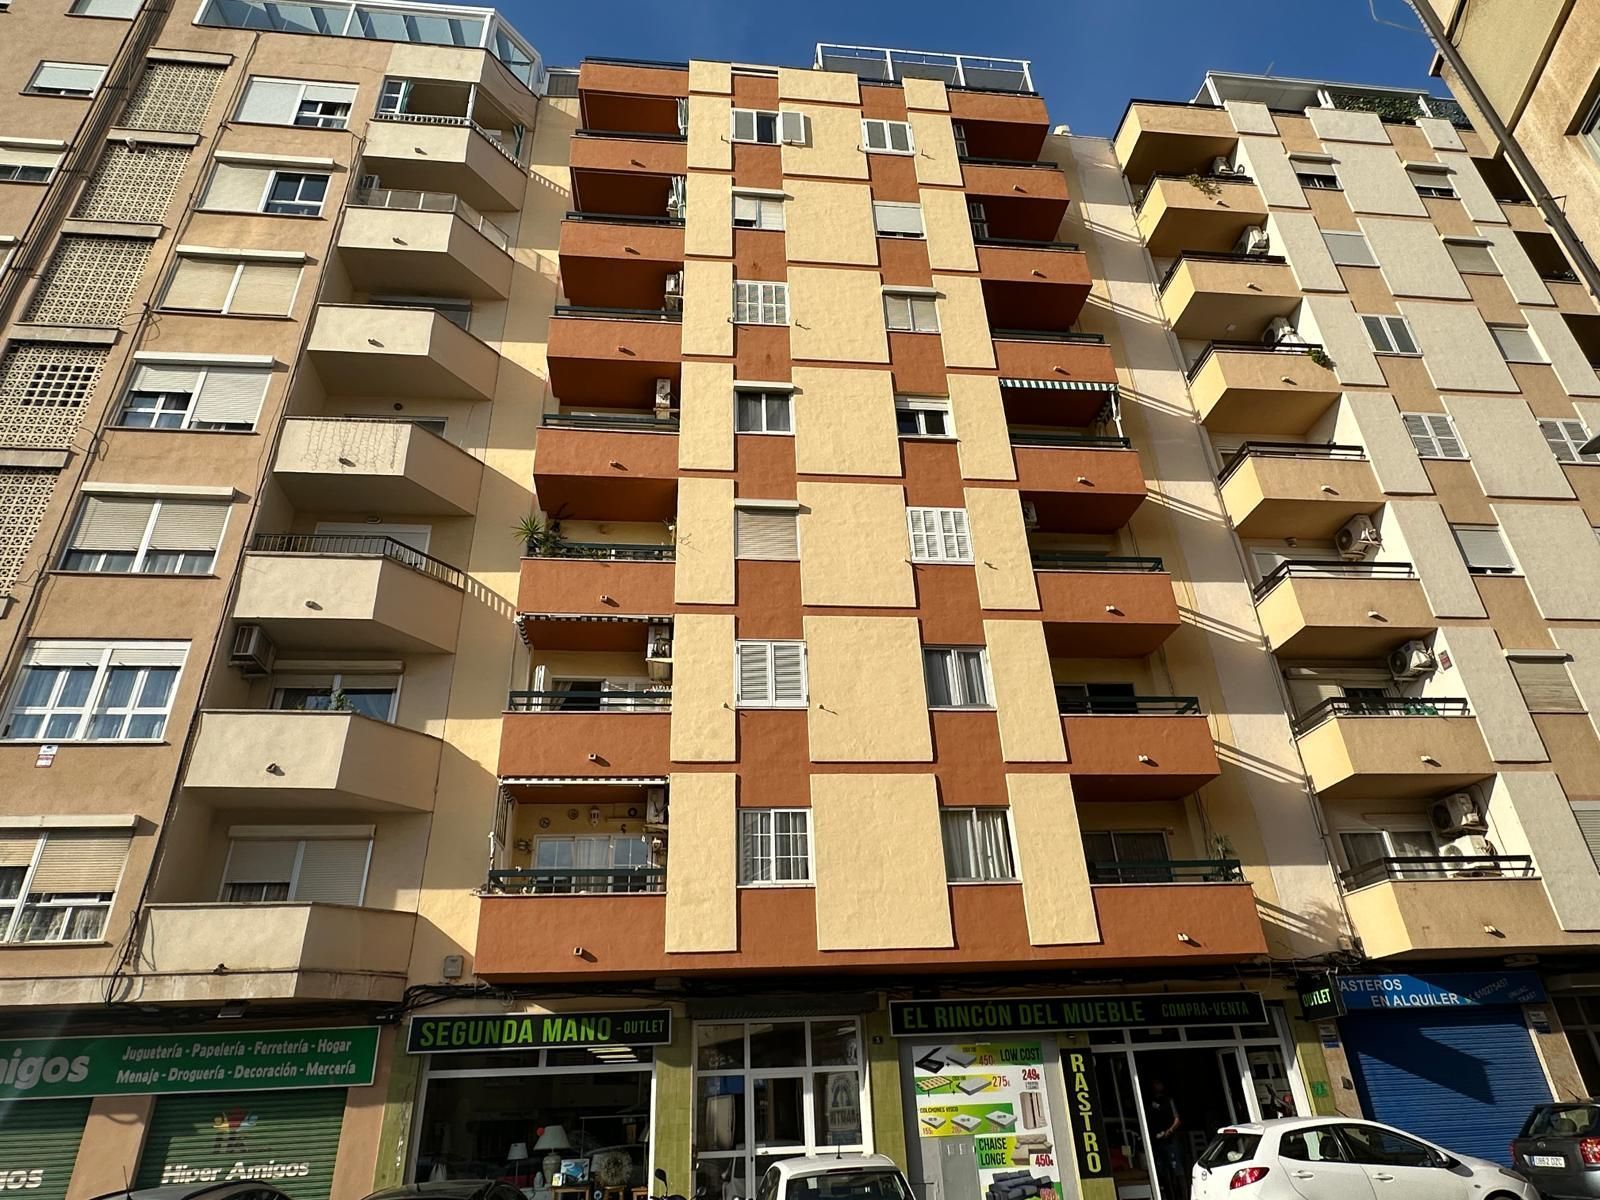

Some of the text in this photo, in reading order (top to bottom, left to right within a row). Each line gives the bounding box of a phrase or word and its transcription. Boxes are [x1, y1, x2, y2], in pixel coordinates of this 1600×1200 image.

[1338, 979, 1402, 991] ASTEROS
[1302, 988, 1332, 1007] OUTLET
[1371, 993, 1460, 1007] EN ALQUILER
[903, 1001, 1249, 1028] EL RINCÓN DEL MUEBLE COMPRA-VENTA
[420, 1018, 533, 1046] SEGUNDA
[542, 1017, 612, 1043] MANO
[122, 1039, 352, 1061] Juguetería Papelería Ferretería Hogar
[1000, 1047, 1040, 1062] LOW COST
[116, 1060, 356, 1085] Menaje Droguería Decoración Mercería
[1070, 1053, 1101, 1173] RASTRO
[979, 1137, 1007, 1151] CHAISE
[980, 1152, 1007, 1166] LONGE
[161, 1160, 310, 1184] Hiper Amigos
